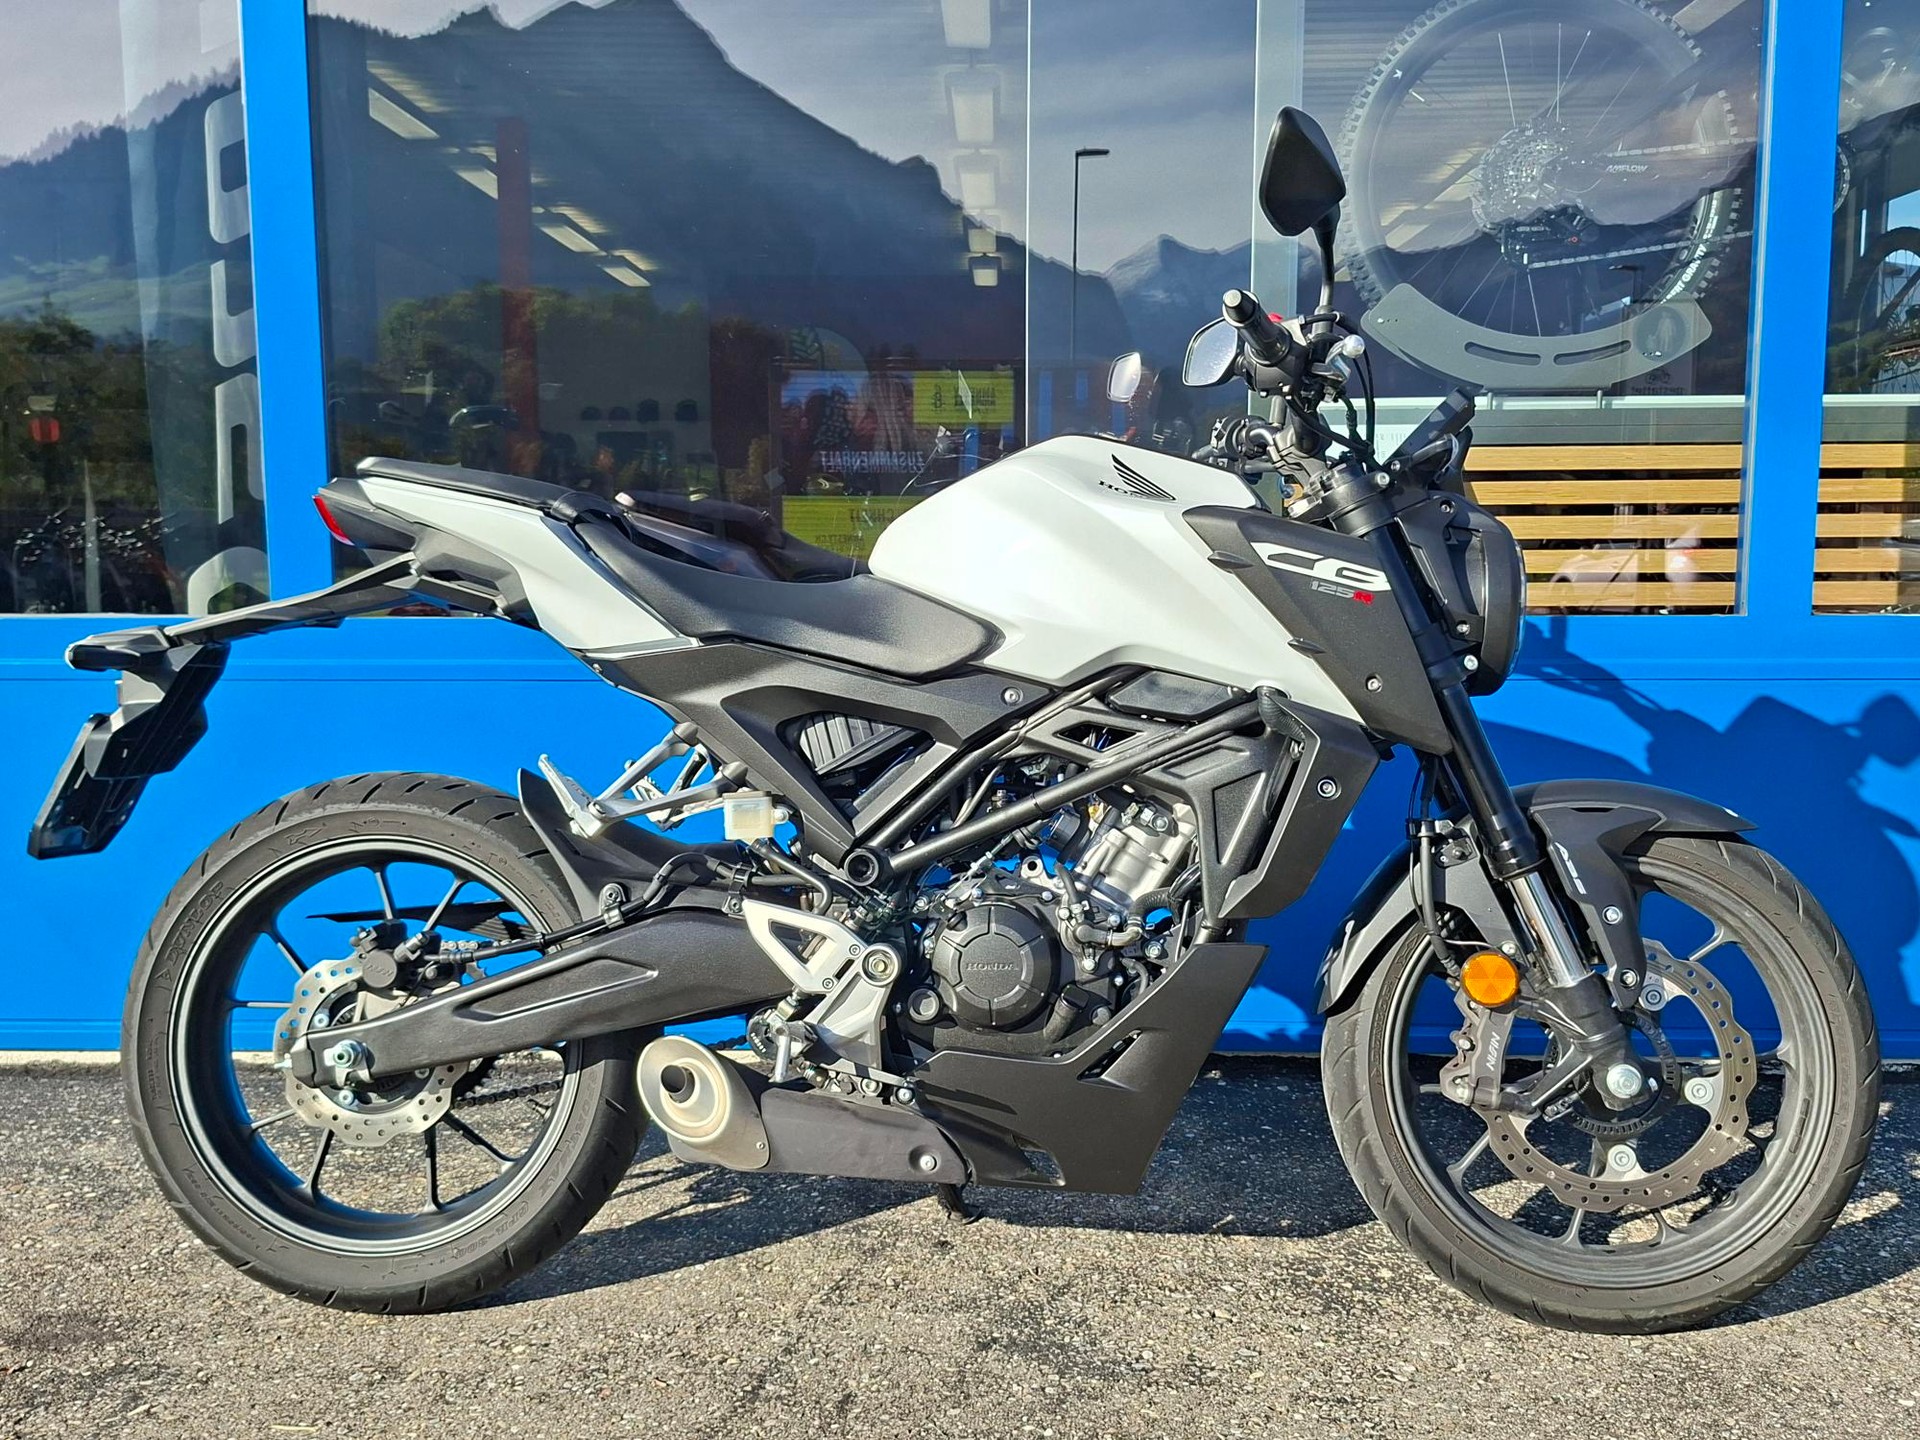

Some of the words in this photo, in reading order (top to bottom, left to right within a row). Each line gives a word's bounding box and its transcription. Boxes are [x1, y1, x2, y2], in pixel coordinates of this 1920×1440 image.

[1250, 542, 1391, 591] CB
[1311, 579, 1375, 605] 125R
[163, 880, 224, 967] DUNLOP
[966, 962, 1020, 971] HONDA
[1486, 1031, 1500, 1071] NISSIN
